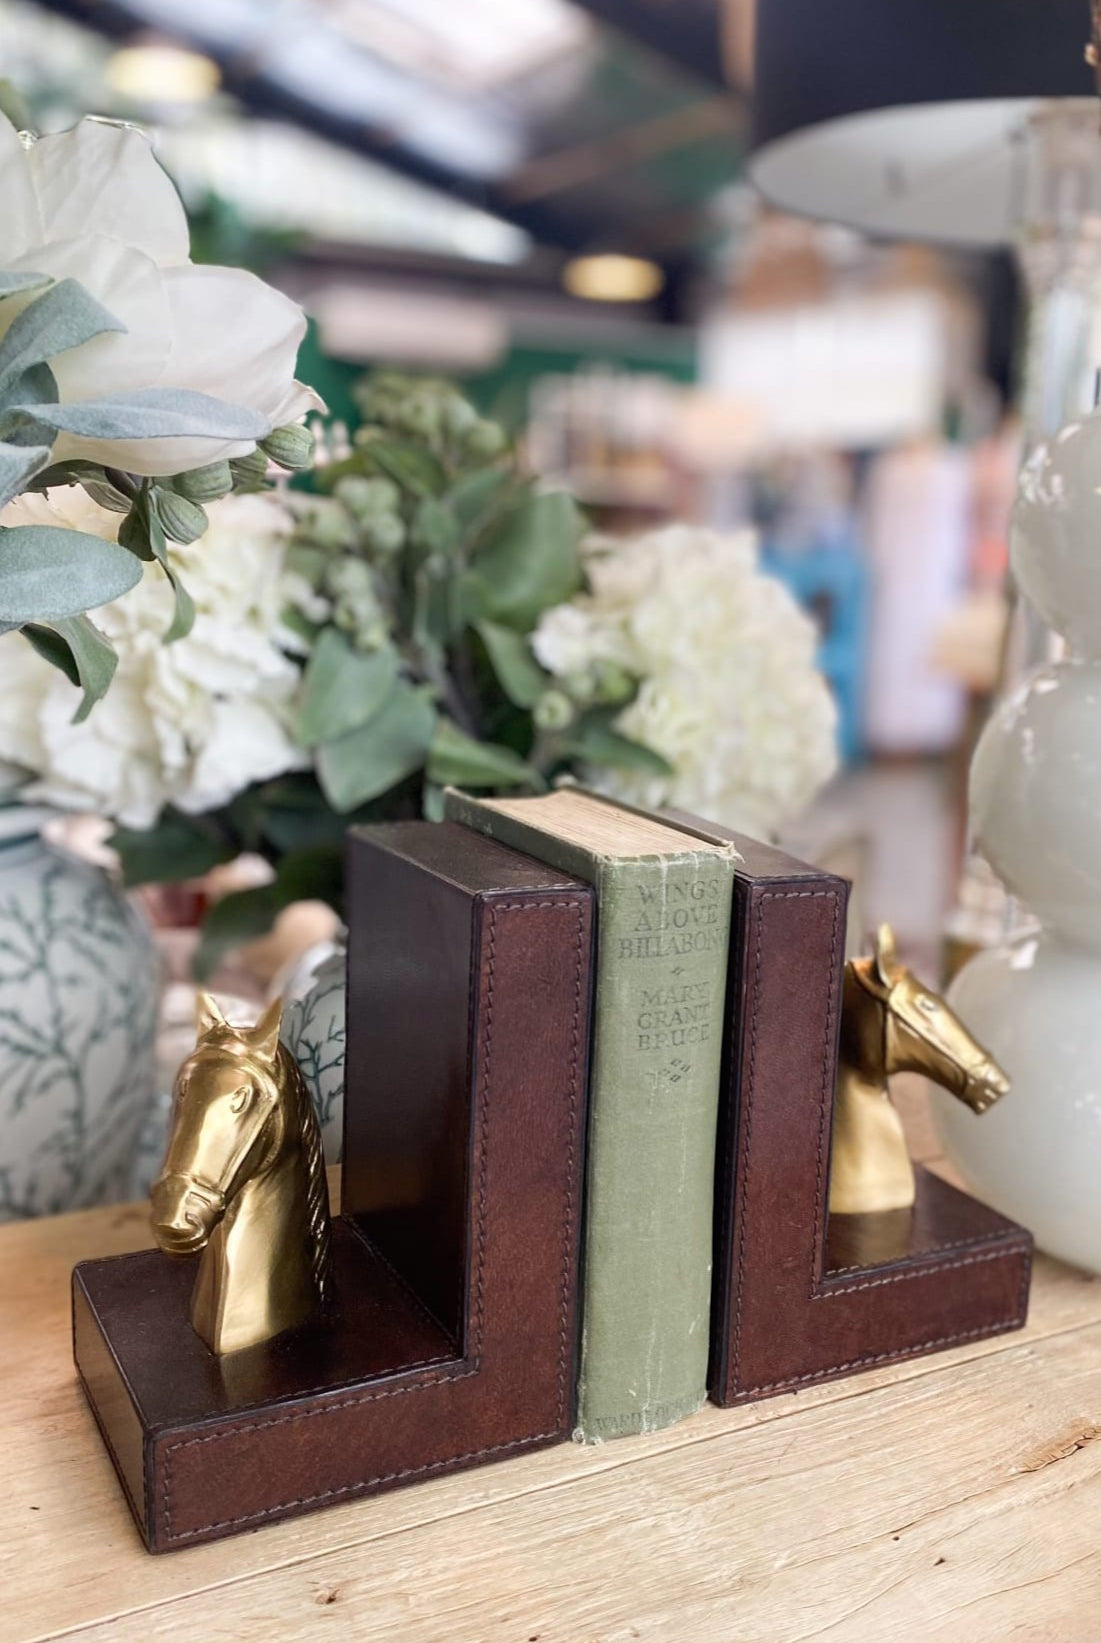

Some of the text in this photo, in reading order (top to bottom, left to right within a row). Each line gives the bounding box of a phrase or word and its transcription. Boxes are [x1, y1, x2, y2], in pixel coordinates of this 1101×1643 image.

[636, 880, 719, 904] WINGS
[634, 905, 717, 931] ABOVE
[641, 981, 710, 1007] MARY
[638, 1003, 710, 1030] GRANT
[637, 1023, 710, 1051] BRUCE
